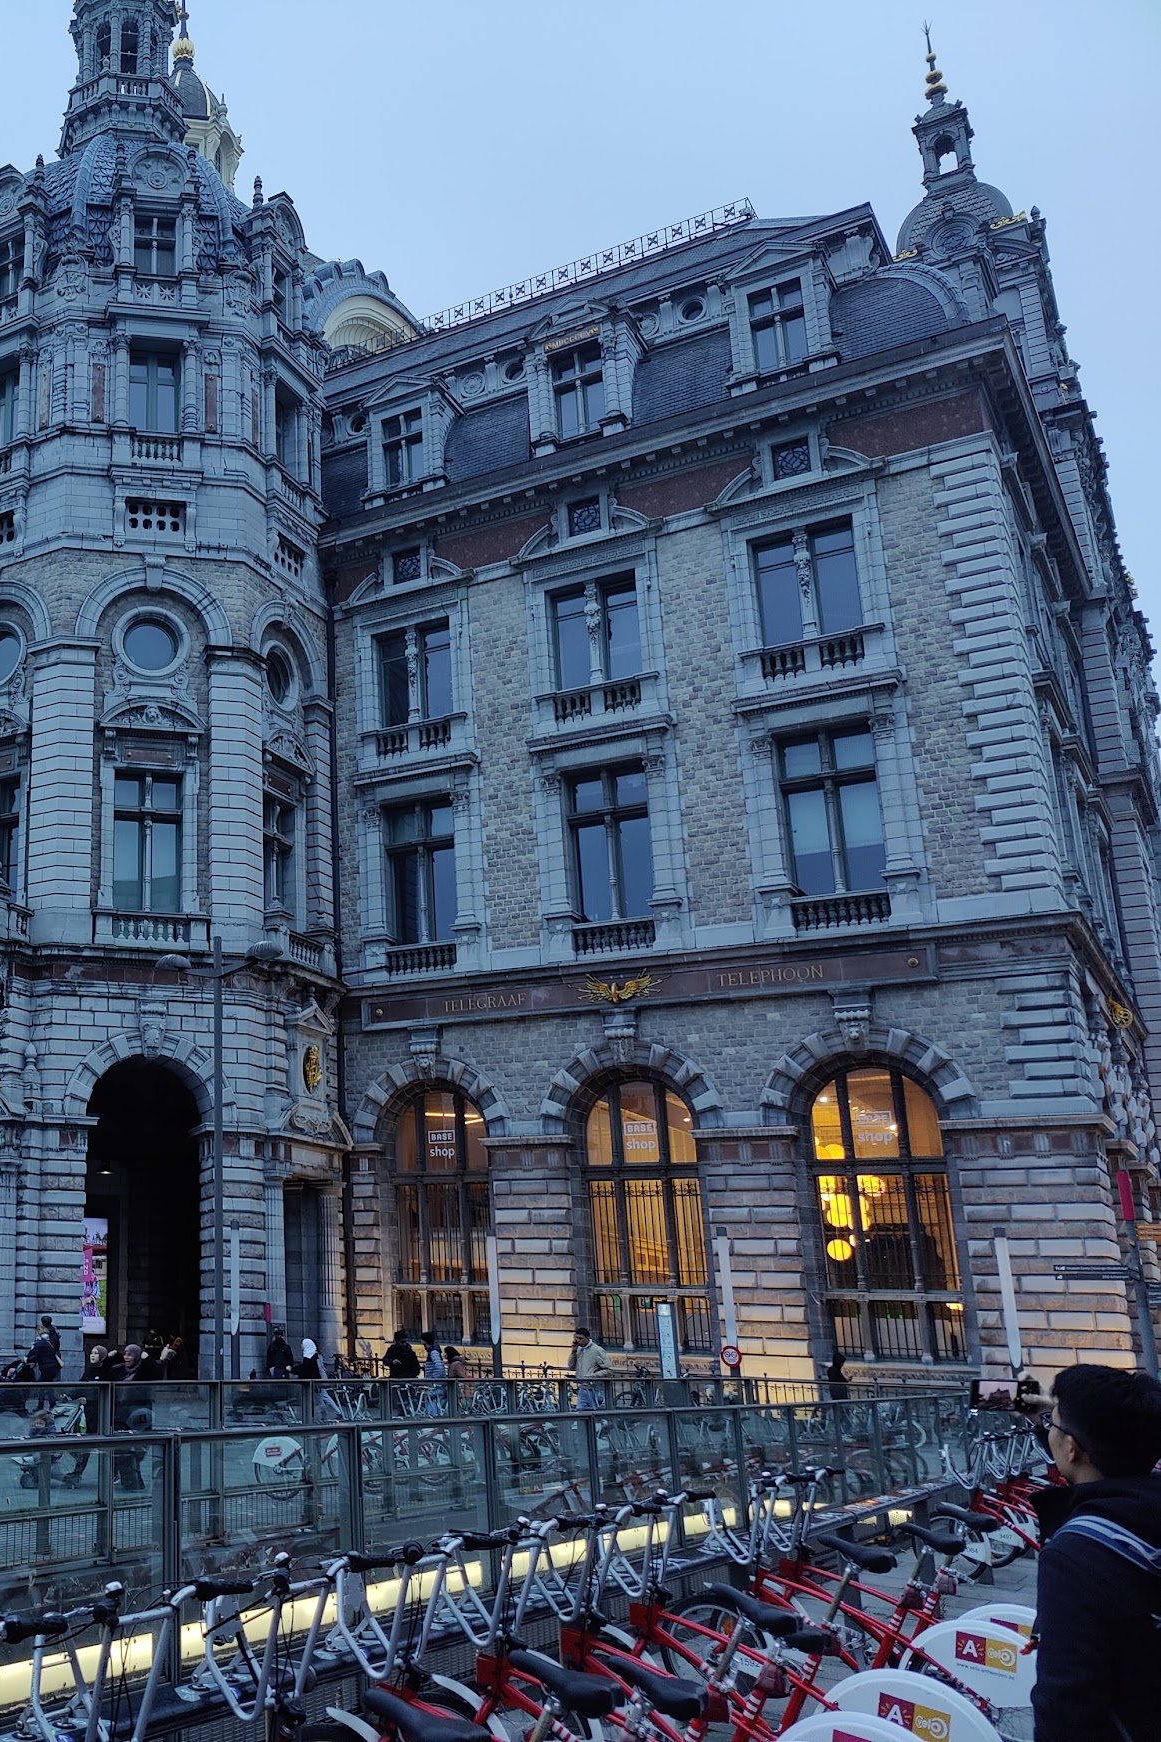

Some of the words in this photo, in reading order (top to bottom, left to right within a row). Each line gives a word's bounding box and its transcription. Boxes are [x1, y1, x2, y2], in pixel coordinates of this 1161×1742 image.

[716, 965, 824, 987] TELEPHOON
[443, 993, 527, 1012] TELEGRAAF
[626, 1137, 655, 1153] shop
[858, 1130, 893, 1145] shop
[429, 1145, 456, 1159] shop
[962, 1639, 978, 1658] A
[739, 1657, 761, 1668] 1592
